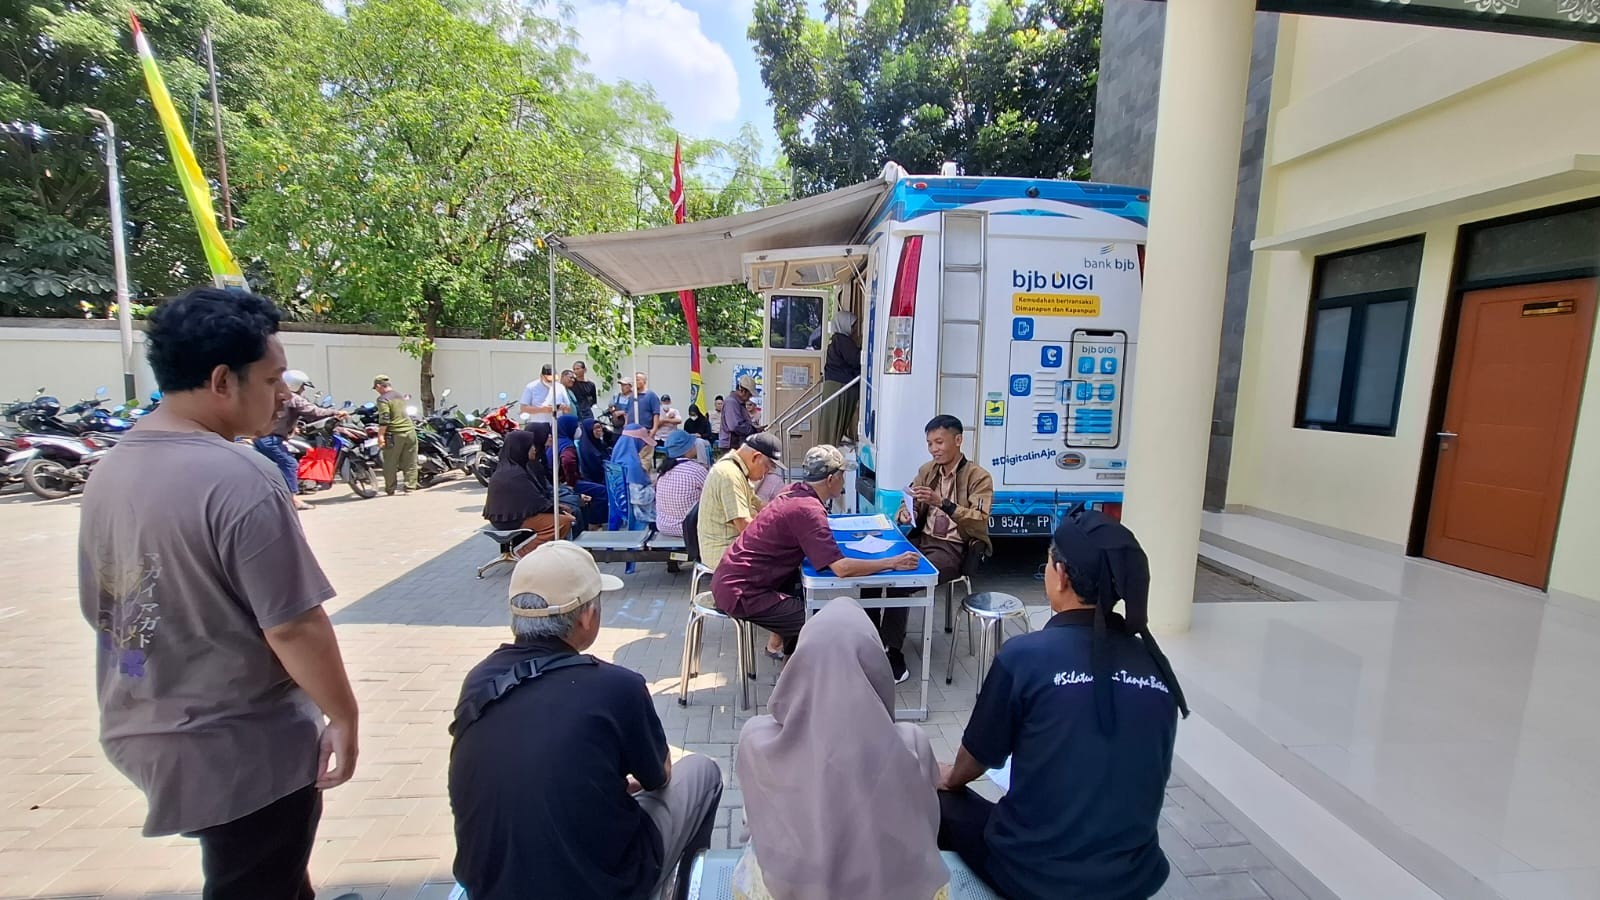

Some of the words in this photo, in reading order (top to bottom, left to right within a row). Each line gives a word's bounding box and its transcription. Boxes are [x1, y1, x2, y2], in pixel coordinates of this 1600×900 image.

[1084, 257, 1112, 269] bank
[1115, 258, 1135, 271] bjb
[1012, 269, 1047, 292] bjb
[1051, 271, 1093, 290] DIGI
[1015, 305, 1052, 313] Dimanapun
[1065, 307, 1096, 315] Kapanpun
[1082, 345, 1097, 355] bjb
[991, 447, 1057, 466] #DigitalinAja
[1001, 516, 1025, 528] 8547
[1037, 516, 1049, 528] FP
[1120, 669, 1151, 689] Tanpa
